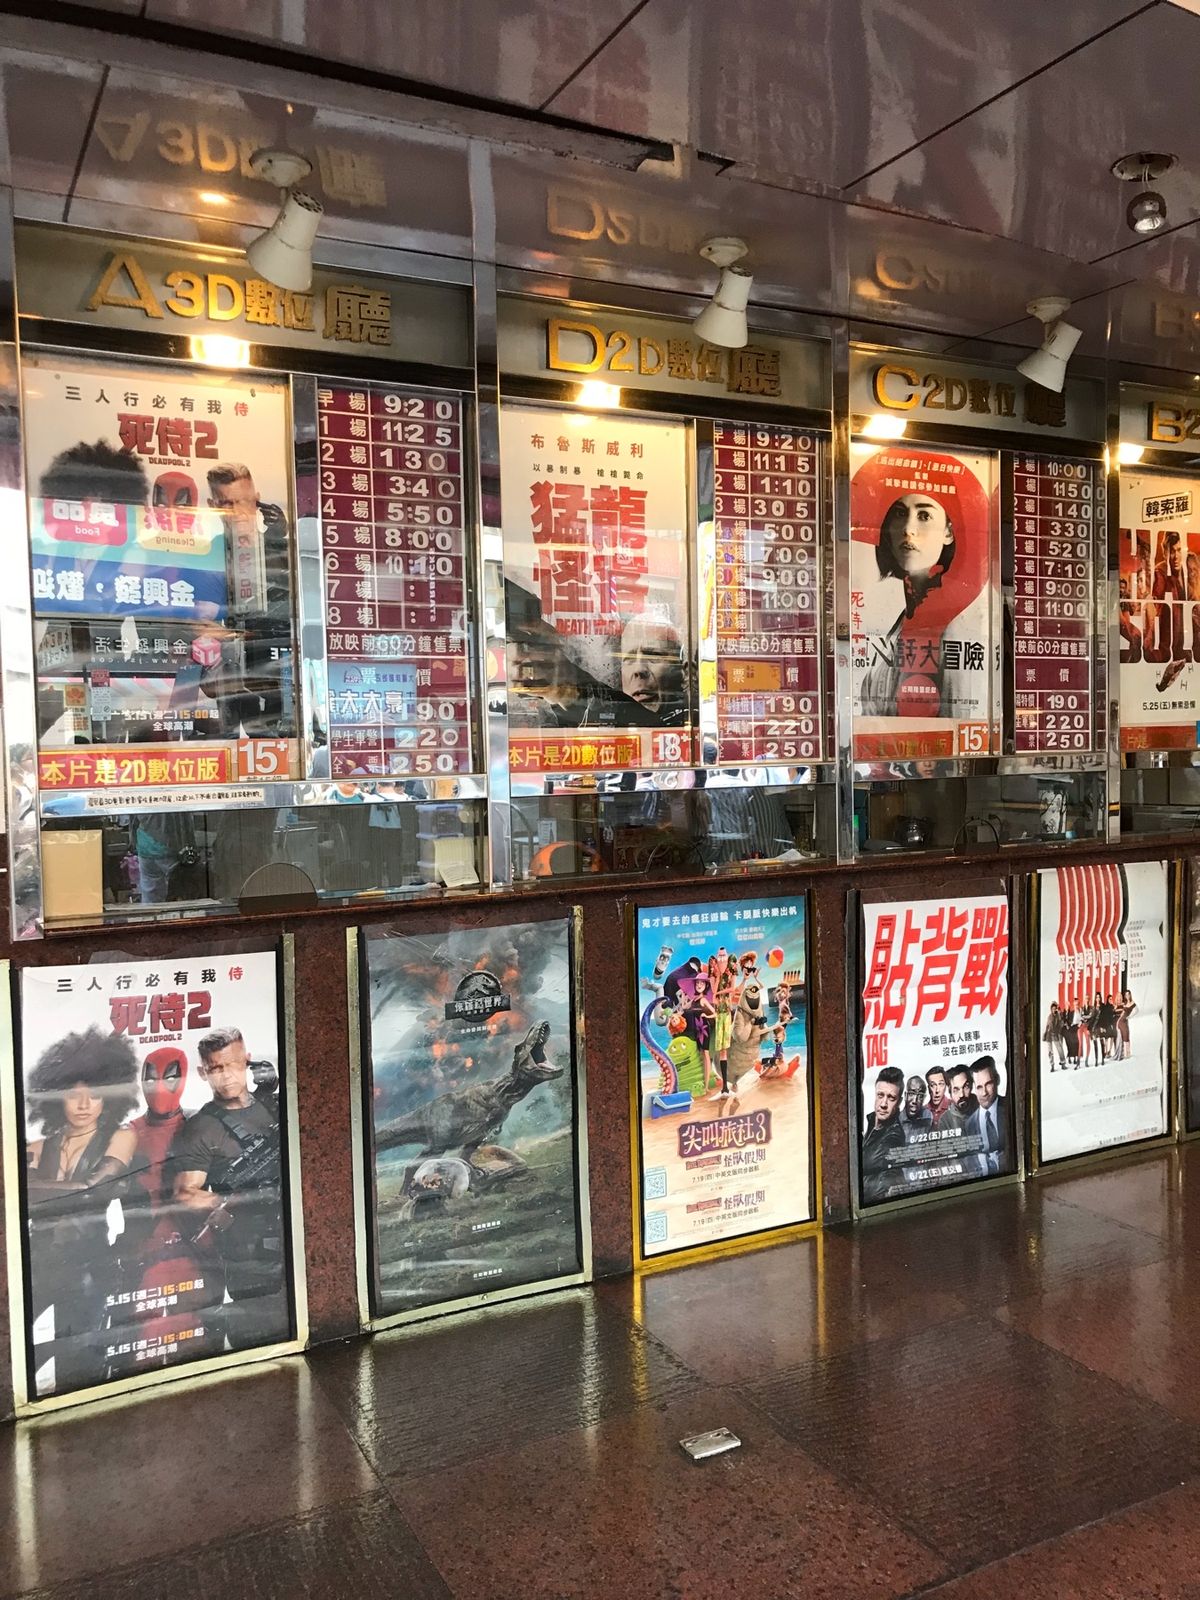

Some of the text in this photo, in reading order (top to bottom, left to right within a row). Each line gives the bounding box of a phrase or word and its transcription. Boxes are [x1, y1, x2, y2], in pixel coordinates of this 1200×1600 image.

[65, 385, 249, 417] 三人行必有我侍
[117, 413, 219, 460] 死侍2
[530, 433, 644, 459] 布魯斯威利
[756, 431, 811, 451] 9:20
[149, 457, 185, 467] DEADPOOL
[533, 463, 644, 480] 以暴制暴 槍槍斃命
[754, 452, 810, 473] 11:15
[1047, 461, 1087, 479] 10:00
[760, 476, 811, 496] 1:10
[1145, 496, 1189, 518] 韓索羅
[763, 523, 813, 542] 5:00
[760, 546, 808, 564] 7:00
[762, 568, 810, 585] 9:00
[1045, 580, 1087, 597] 9:00
[1045, 601, 1086, 616] 11:00
[329, 632, 462, 655] 放映前60分鐘售票
[401, 701, 456, 721] 190
[766, 697, 812, 713] 190
[1046, 694, 1078, 709] 190
[153, 720, 194, 731] 全球高潮
[766, 718, 814, 736] 220
[1045, 714, 1084, 730] 220
[331, 728, 459, 749] 學生軍警 220
[1046, 732, 1084, 748] 250
[508, 744, 633, 767] 本片是2D數位版
[766, 741, 814, 758] 250
[41, 755, 219, 785] 本片是2D數位版
[393, 753, 456, 773] 250
[642, 911, 729, 928] 鬼才要去的瘋狂遊輪
[862, 904, 1009, 1031] 貼背戰
[56, 966, 243, 993] 三人行必有我侍
[108, 990, 211, 1037] 死侍2
[454, 996, 502, 1012] 侏羅紀世界
[139, 1033, 183, 1045] DEADPOOL 2
[923, 1030, 980, 1048] 改編自真人瞎事
[865, 1032, 889, 1068] TAG
[942, 1041, 999, 1057] 沒在跟你開玩笑
[682, 1112, 767, 1155] 尖叫旅社3
[723, 1148, 766, 1168] 怪獸假期
[723, 1190, 766, 1211] 怪獸假期
[136, 1295, 178, 1312] 全球高潮
[136, 1342, 178, 1362] 全球高潮
